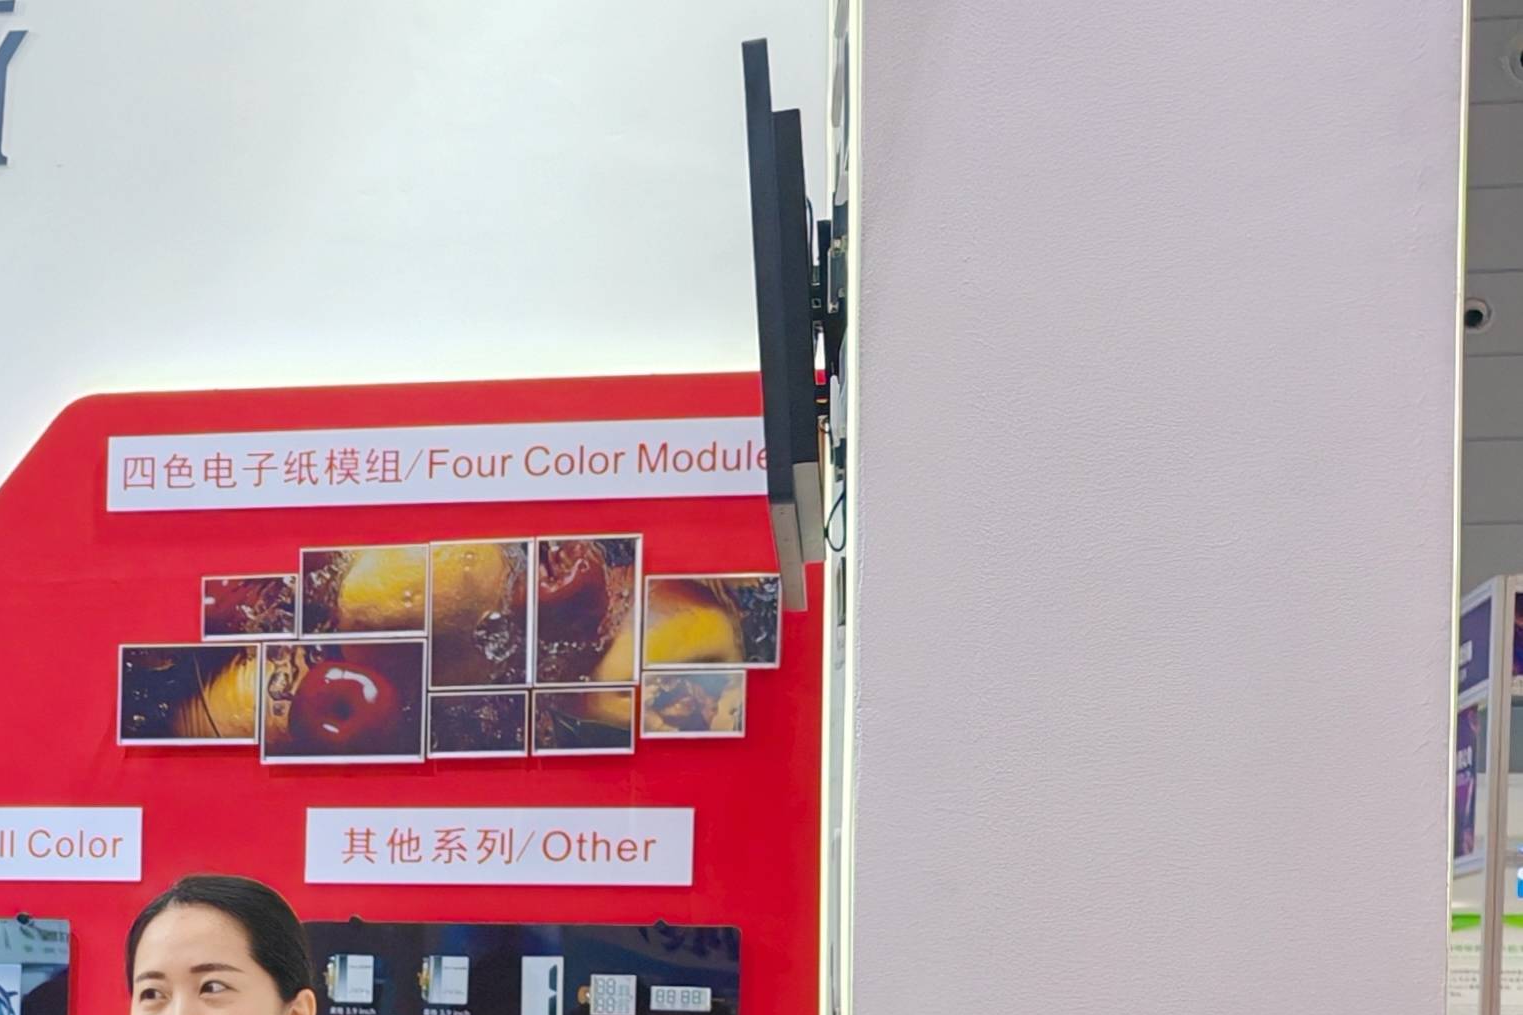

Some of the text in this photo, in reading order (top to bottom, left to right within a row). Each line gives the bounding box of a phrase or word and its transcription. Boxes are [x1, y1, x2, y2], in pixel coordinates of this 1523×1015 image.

[523, 442, 626, 478] Color
[637, 439, 769, 474] Module
[27, 829, 124, 859] Color
[341, 827, 658, 865] 其他系列/Other
